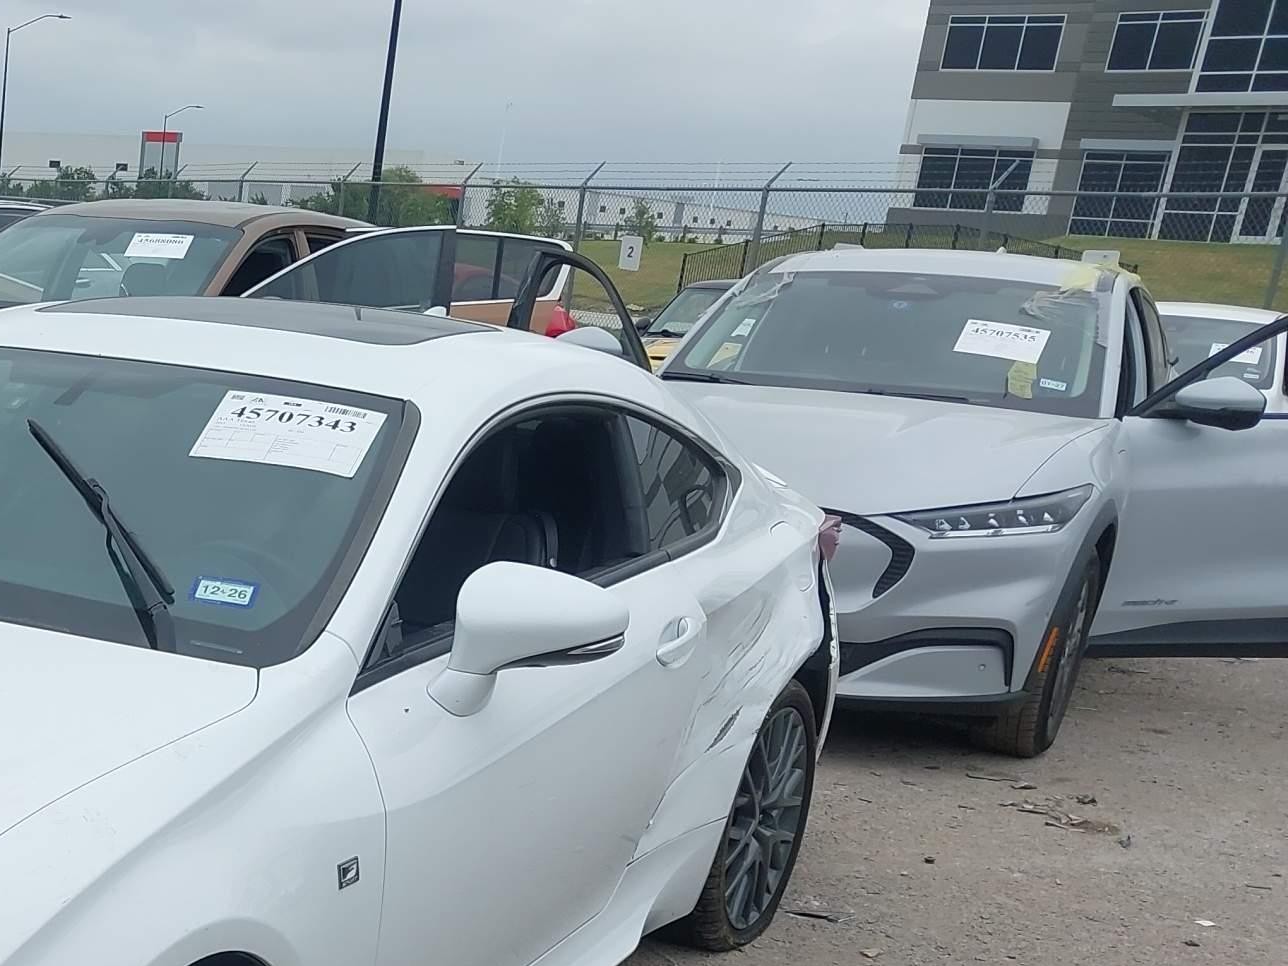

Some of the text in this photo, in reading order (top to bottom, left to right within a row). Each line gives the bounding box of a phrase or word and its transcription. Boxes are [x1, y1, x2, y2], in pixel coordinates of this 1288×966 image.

[627, 246, 634, 258] 2
[970, 327, 1038, 342] 45707535
[230, 405, 358, 434] 45707343
